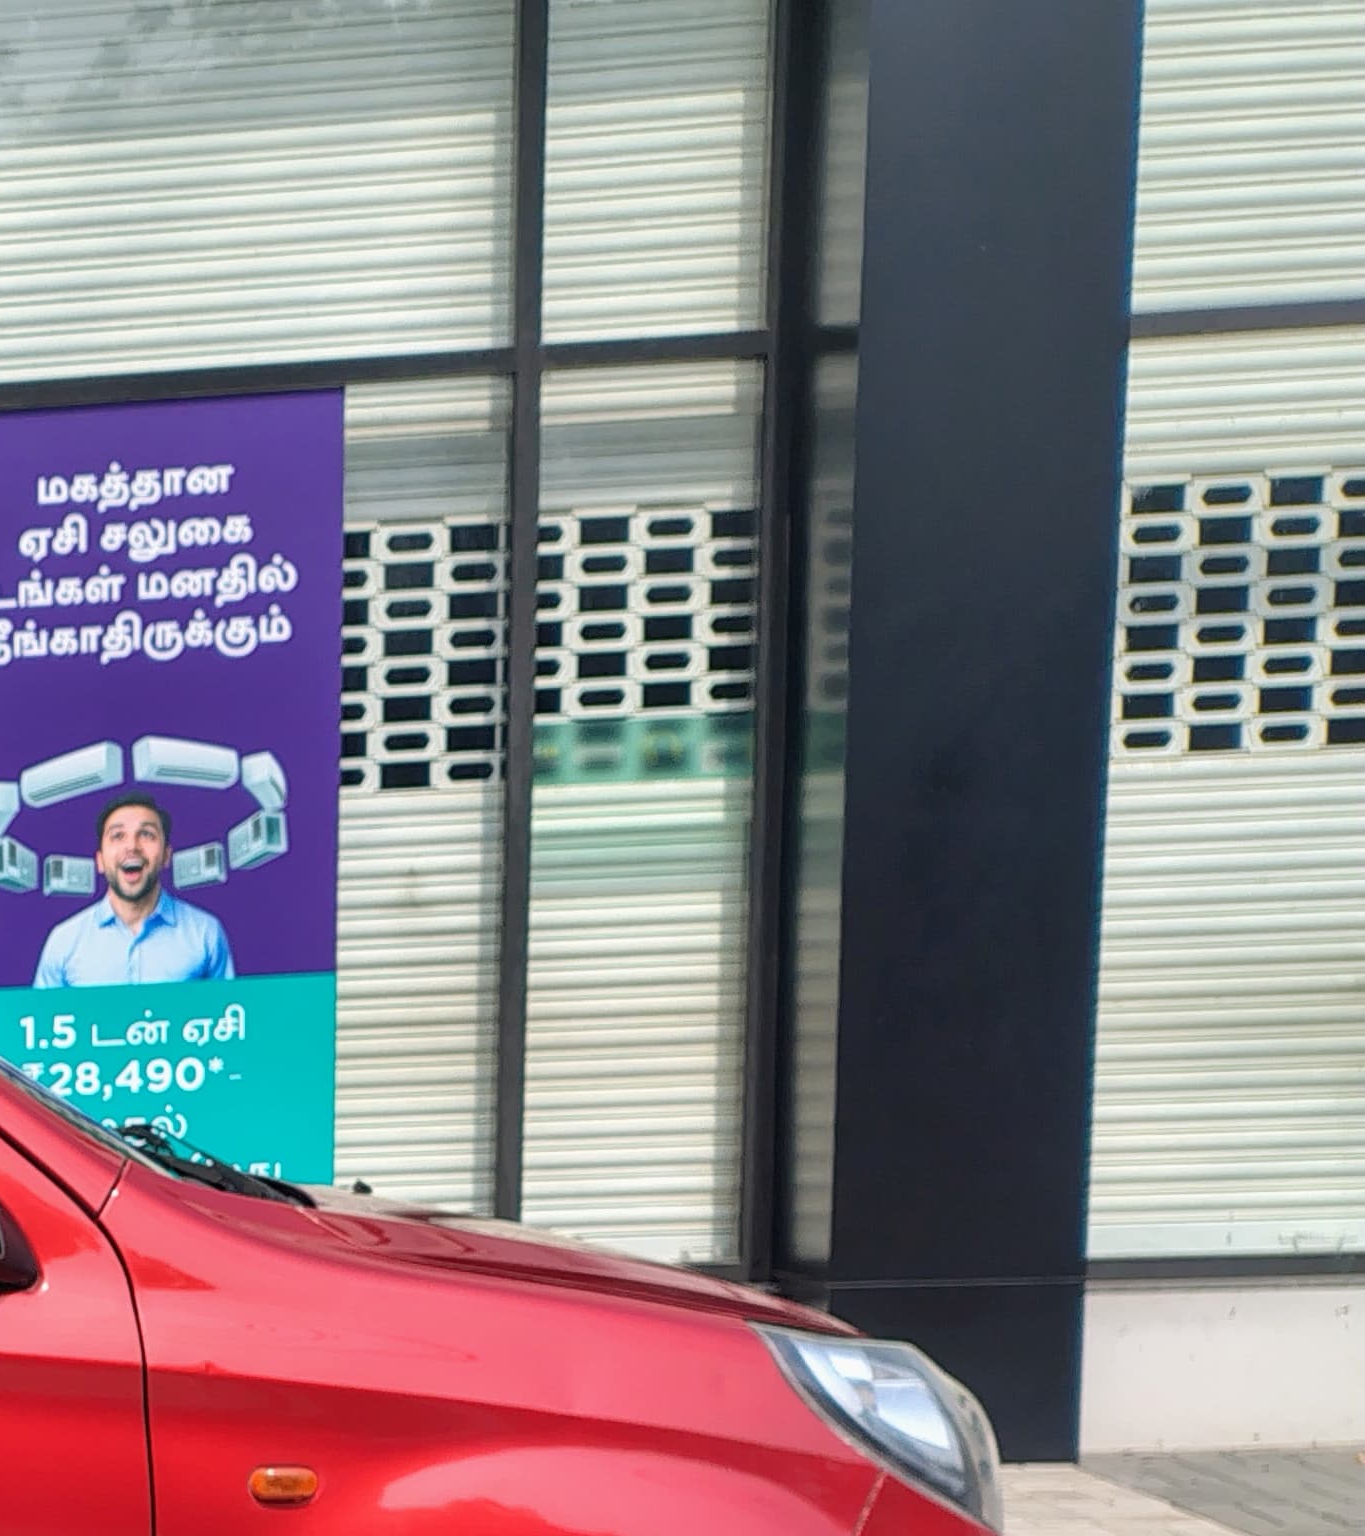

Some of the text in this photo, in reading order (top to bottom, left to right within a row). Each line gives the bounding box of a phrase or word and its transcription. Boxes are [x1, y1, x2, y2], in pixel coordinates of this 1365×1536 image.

[37, 462, 235, 513] மகத்தான
[18, 513, 255, 562] ஏசி சலுகை
[137, 552, 300, 608] மனதில்
[19, 1003, 246, 1050] 1.5 டன் ஏசி
